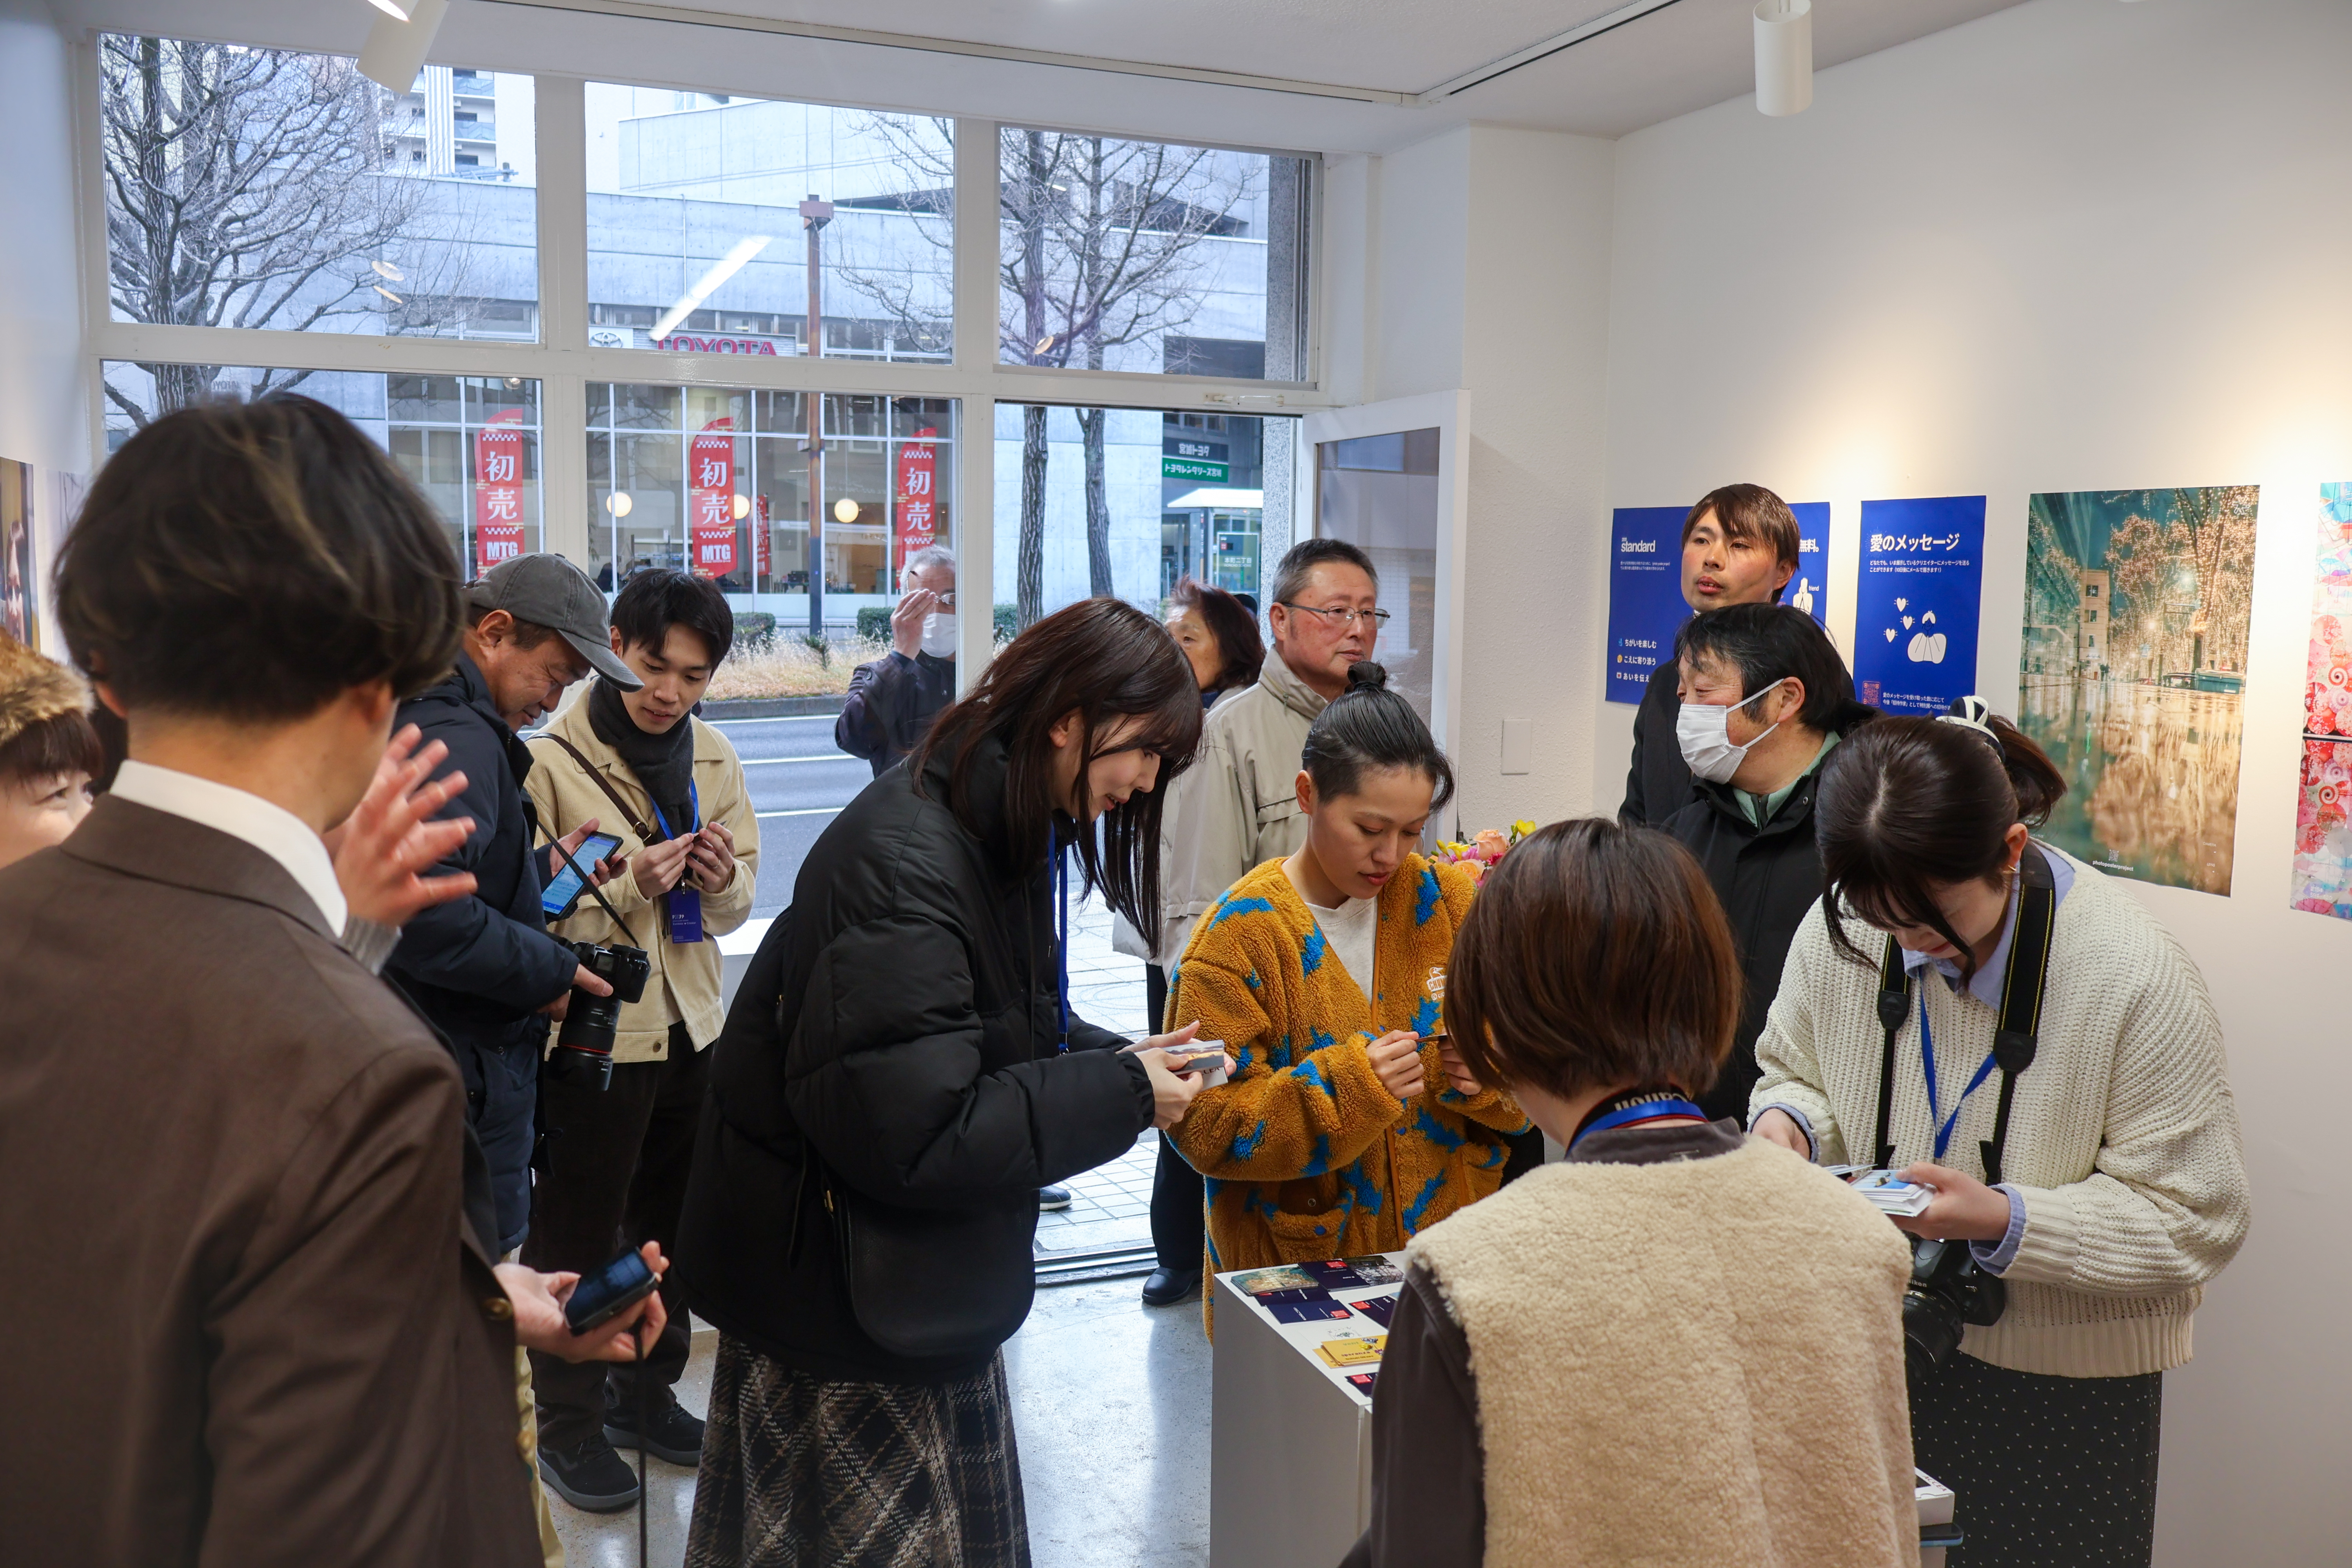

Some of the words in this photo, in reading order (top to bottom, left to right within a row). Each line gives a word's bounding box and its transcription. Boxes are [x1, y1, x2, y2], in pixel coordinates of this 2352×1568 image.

[657, 336, 777, 356] TOYOTA
[484, 452, 517, 521] 初売
[698, 458, 731, 525] 初売
[905, 467, 932, 531] 初売
[486, 541, 518, 557] MTG
[1621, 540, 1656, 552] standard
[1870, 533, 1960, 552] 愛のメッセージ
[702, 544, 731, 560] MTG
[1625, 639, 1657, 649] ちがいを楽しむ
[1624, 656, 1656, 666] こえに寄り添う
[2092, 860, 2134, 871] photoposterproject
[1201, 1067, 1220, 1075] CEA
